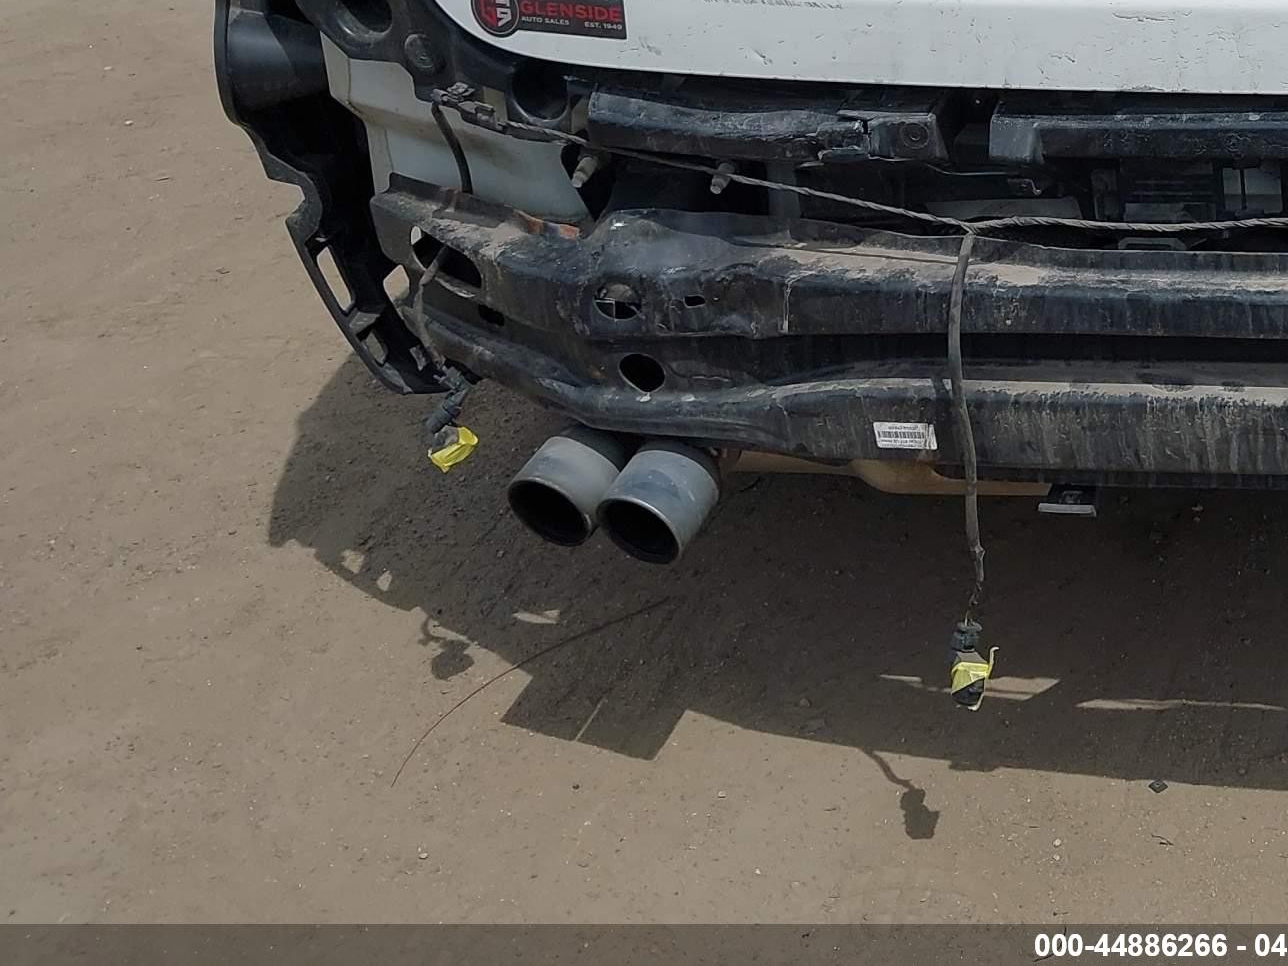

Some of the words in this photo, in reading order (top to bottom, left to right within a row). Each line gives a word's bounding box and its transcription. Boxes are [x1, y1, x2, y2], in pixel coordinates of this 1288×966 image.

[520, 0, 623, 22] GLENSIDE
[544, 18, 570, 26] SALES
[584, 21, 602, 29] EST.
